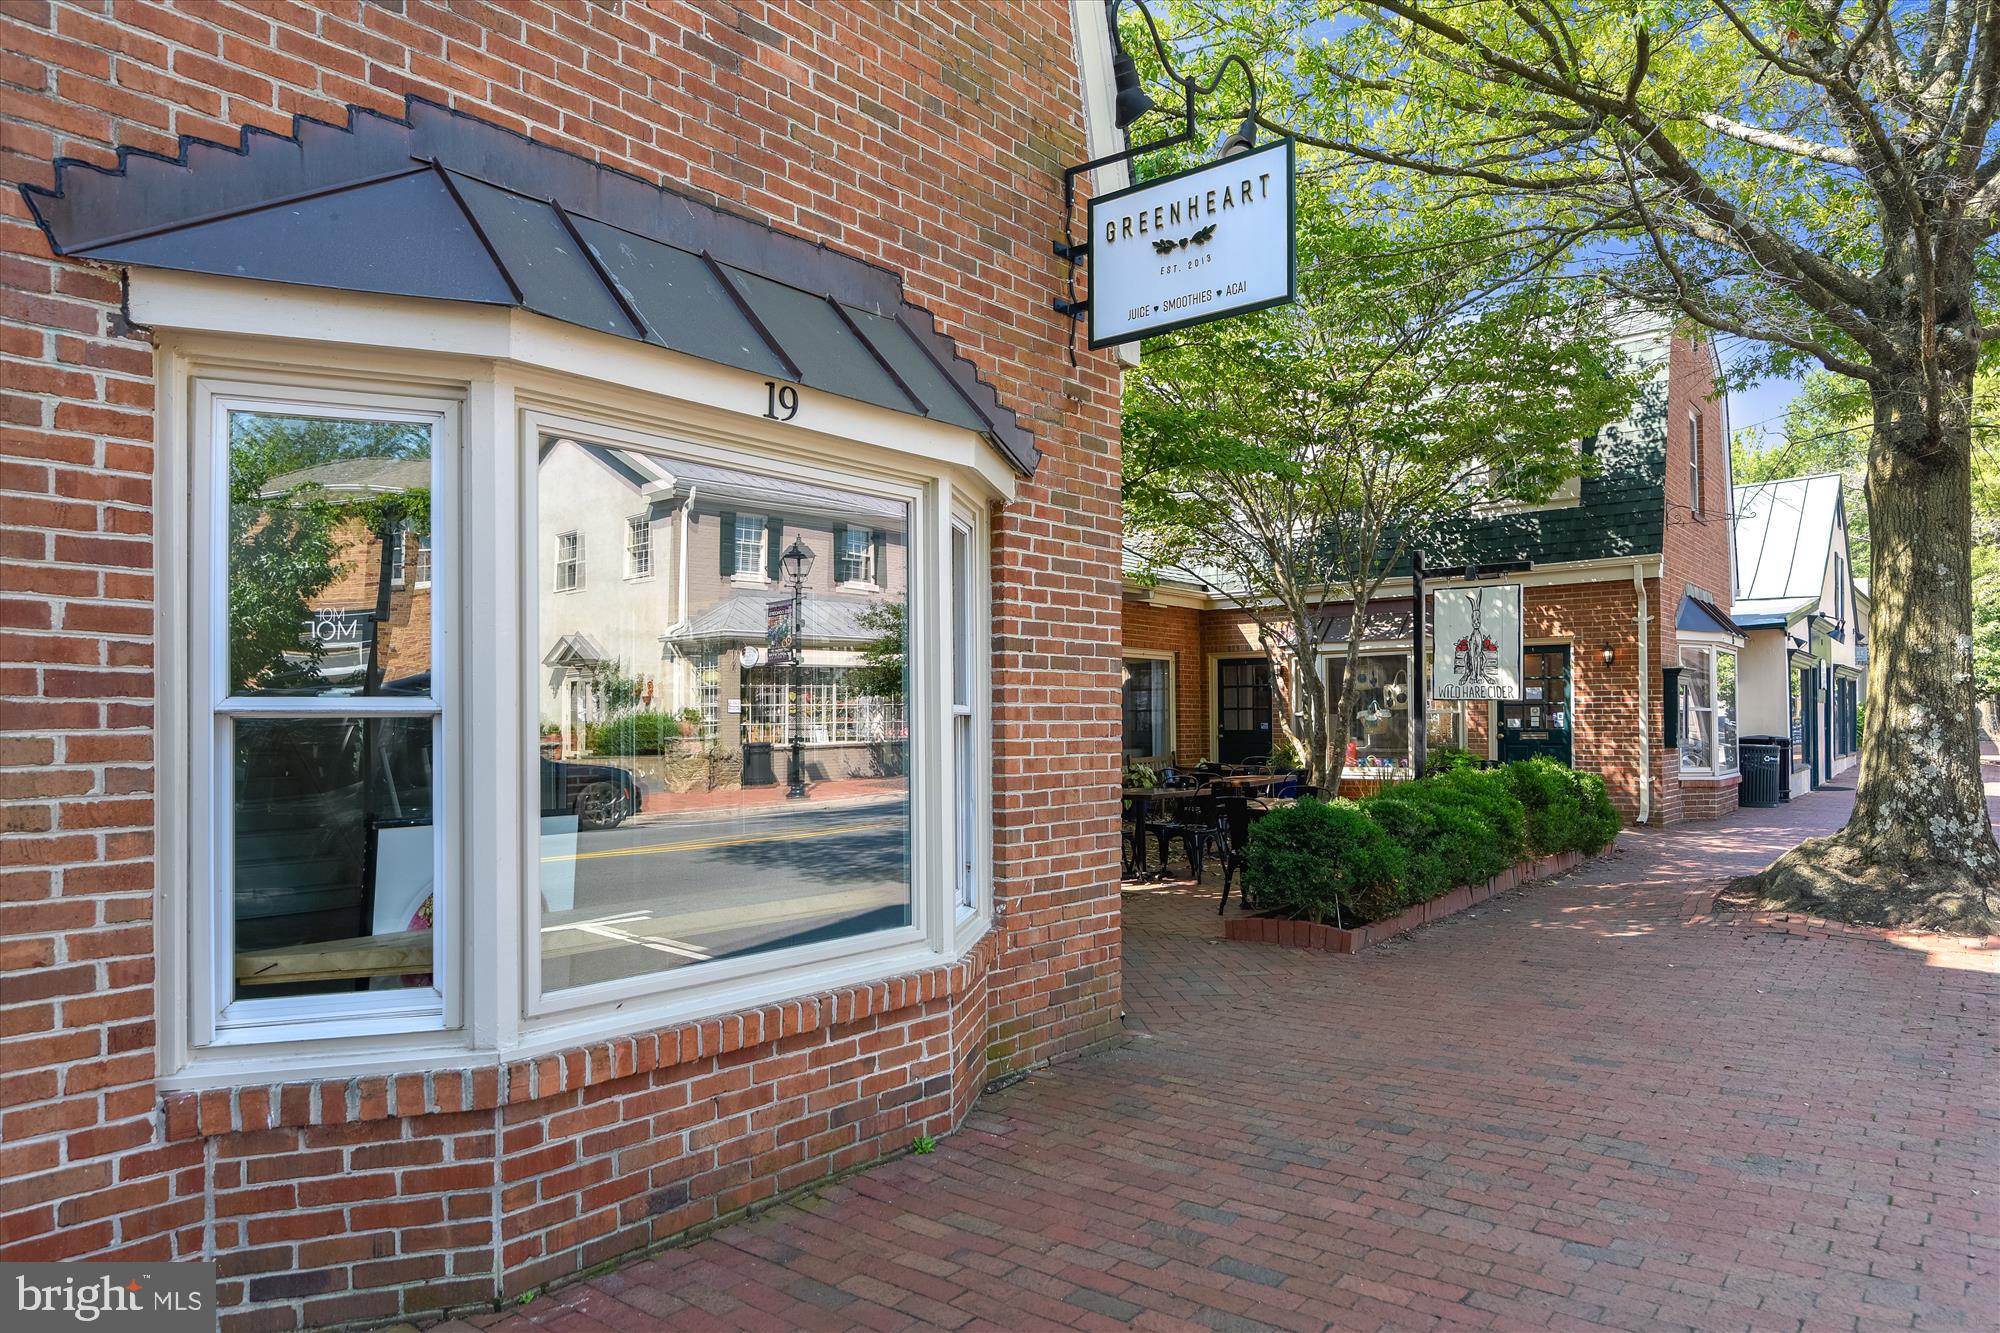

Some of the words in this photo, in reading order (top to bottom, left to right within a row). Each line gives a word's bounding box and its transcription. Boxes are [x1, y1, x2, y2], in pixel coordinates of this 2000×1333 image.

[1106, 173, 1270, 243] GREENHEART
[1160, 265, 1181, 275] EST.
[1188, 254, 1212, 270] 2013
[1127, 305, 1150, 321] JUICE
[1163, 289, 1212, 312] SMOOTHIES
[1225, 281, 1247, 297] ACAI
[763, 382, 799, 421] 19
[1438, 684, 1460, 698] WILD
[1462, 686, 1486, 698] HARE
[1487, 686, 1514, 698] CIDER
